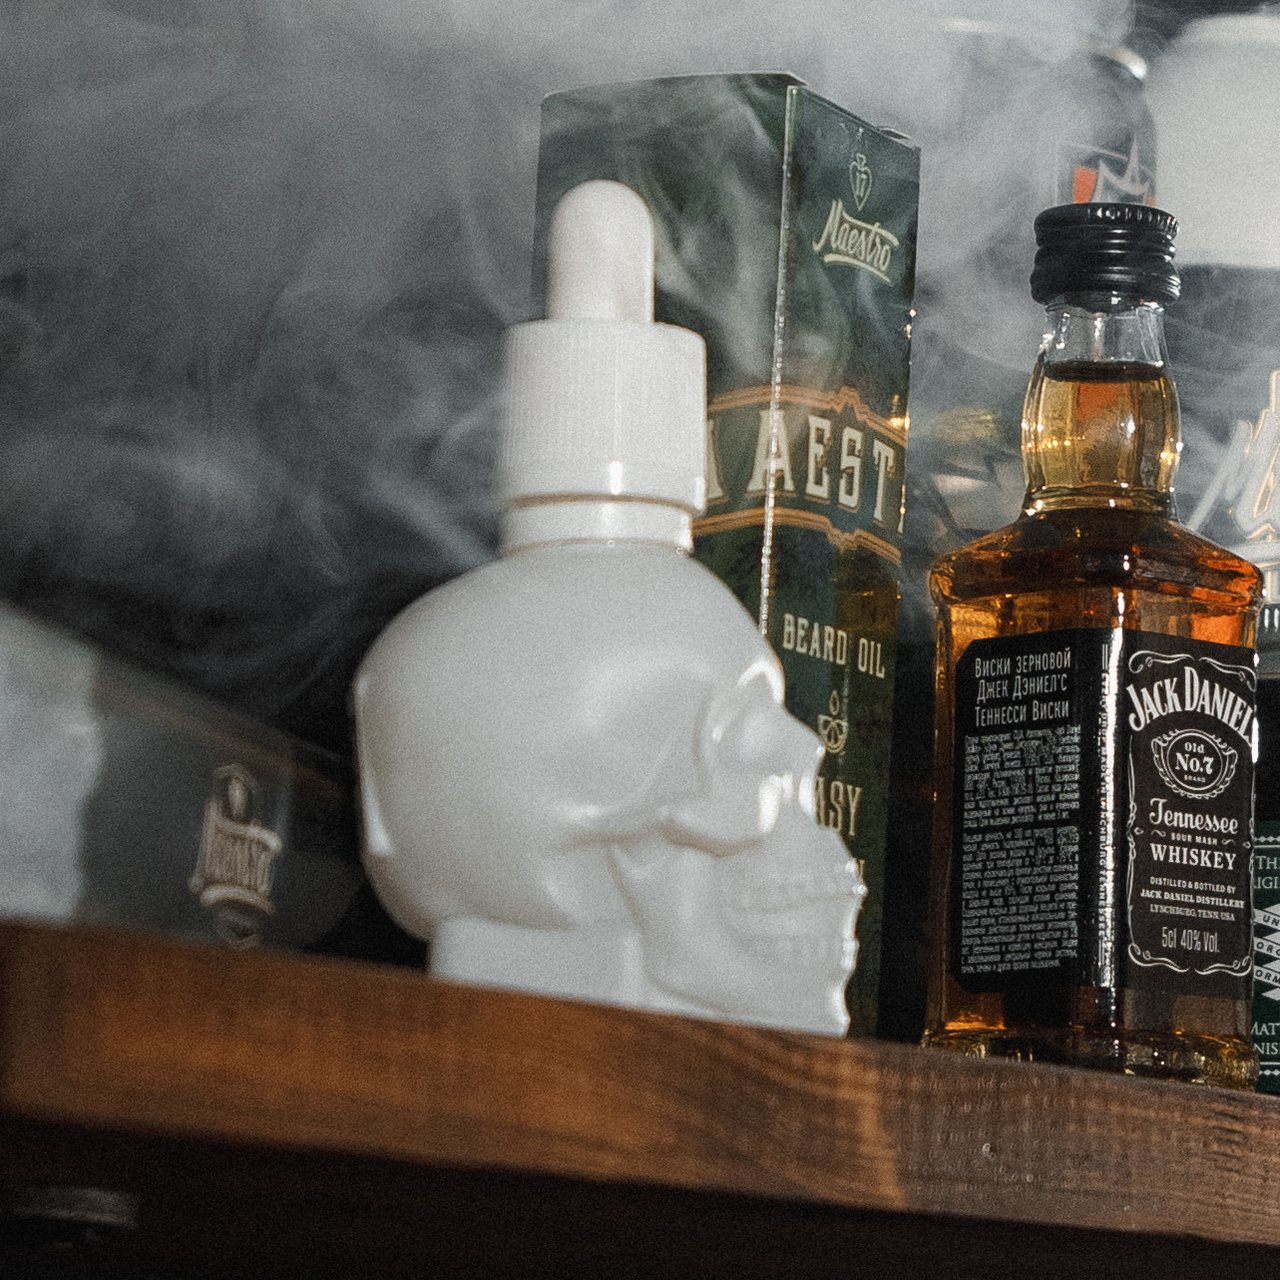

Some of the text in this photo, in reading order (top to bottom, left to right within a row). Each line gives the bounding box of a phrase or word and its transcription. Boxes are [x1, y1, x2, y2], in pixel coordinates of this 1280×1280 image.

[811, 198, 899, 273] Maestro
[707, 410, 904, 534] AEST
[782, 612, 885, 680] BEARD OIL
[1126, 677, 1183, 732] JACK
[1184, 742, 1205, 754] Old
[1100, 746, 1108, 778] MADE
[1100, 781, 1108, 794] IN
[1184, 774, 1206, 783] BRAND
[1149, 797, 1239, 834] Tennessee
[1099, 797, 1107, 866] LYNCHBURG
[1171, 832, 1218, 846] SOUR MASH
[1149, 843, 1237, 870] WHISKEY
[1140, 888, 1245, 909] JACK DANIEL DISTILLERY
[1150, 876, 1236, 894] DISTILLED & BOTTLED BY
[1098, 870, 1107, 937] TENNESSEE
[1220, 911, 1235, 921] USA
[1161, 926, 1220, 953] 5cl 40% Vol.
